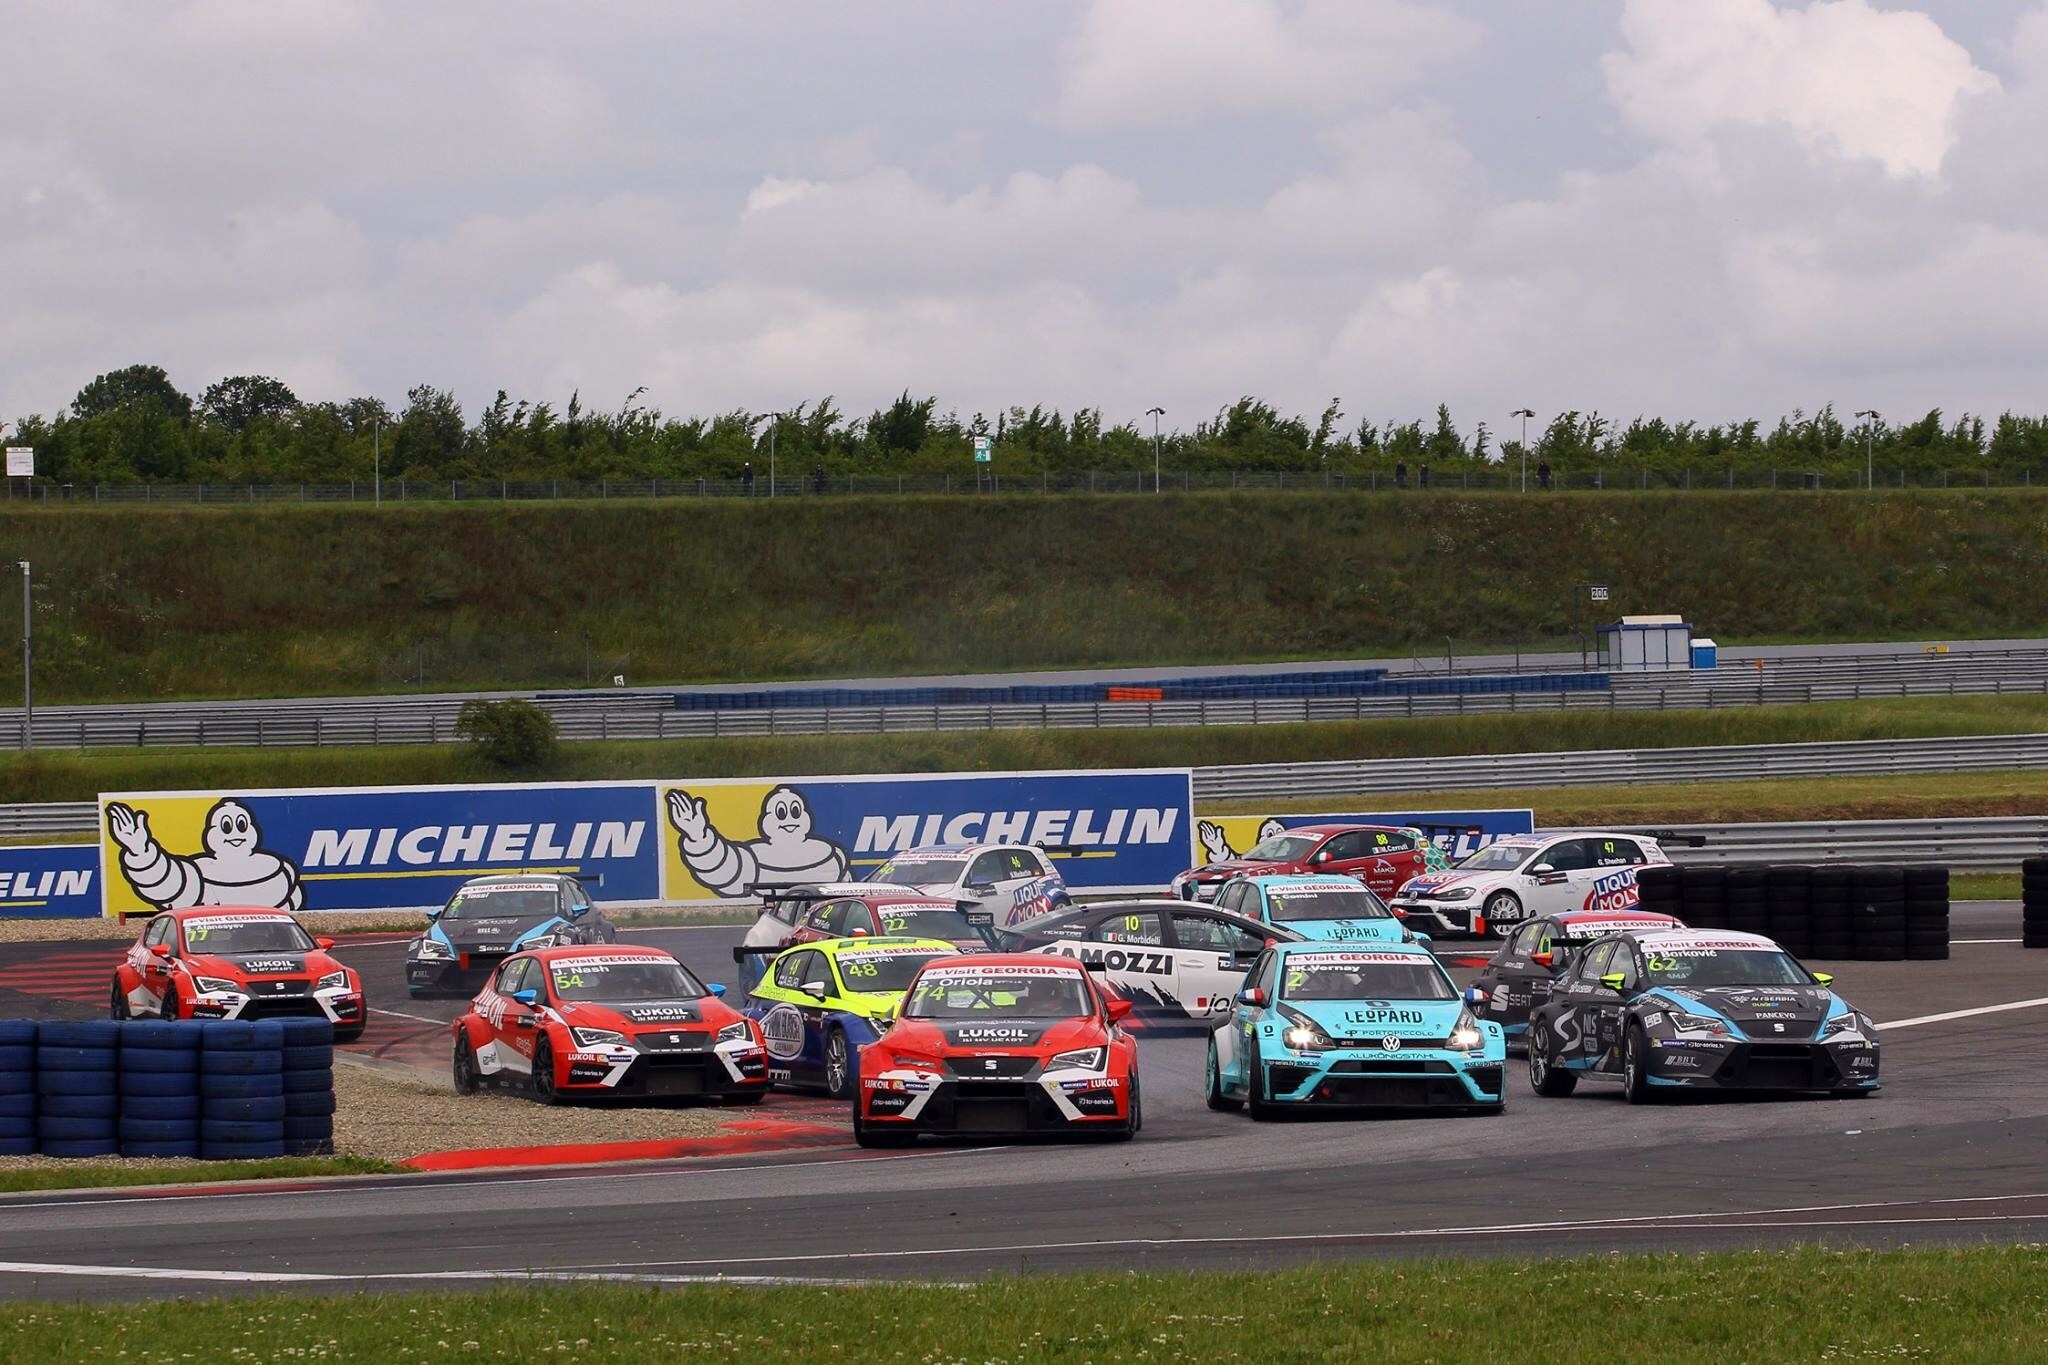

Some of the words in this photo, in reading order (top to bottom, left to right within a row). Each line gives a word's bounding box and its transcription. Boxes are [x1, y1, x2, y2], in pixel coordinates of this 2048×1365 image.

[853, 808, 1179, 853] MICHELIN
[302, 821, 646, 867] MICHELIN
[1376, 834, 1389, 845] 88
[1603, 841, 1614, 853] 47
[1594, 869, 1637, 895] LIQUI
[1013, 880, 1042, 905] LIQUI
[1279, 885, 1302, 893] Visit
[1598, 884, 1640, 911] MOLY
[1016, 896, 1050, 923] MOLY
[884, 918, 908, 932] 22
[1124, 915, 1139, 931] 10
[187, 929, 209, 942] 77
[1327, 927, 1380, 939] LEOPARD
[1117, 934, 1126, 943] G.
[1127, 933, 1161, 946] Morbidelli
[1694, 941, 1761, 949] GEORGIA
[852, 949, 882, 957] Visit
[884, 947, 944, 955] GEORGIA
[1303, 954, 1336, 963] Visit
[1339, 953, 1411, 962] GEORGIA
[246, 960, 295, 968] LUKOIL
[567, 956, 596, 965] Visit
[599, 955, 659, 963] GEORGIA
[1648, 957, 1679, 972] 62
[554, 967, 568, 976] J.
[572, 965, 610, 975] Nash
[849, 963, 878, 977] 48
[943, 967, 977, 976] Visit
[981, 966, 1058, 975] GEORGIA
[555, 974, 585, 989] 54
[941, 977, 993, 988] Oriola
[1287, 972, 1303, 988] 2
[916, 986, 944, 1003] 74
[1509, 994, 1533, 1006] SEAT
[631, 1007, 689, 1017] LUKOIL
[1344, 1009, 1423, 1024] LEOPARD
[958, 1028, 1029, 1038] LUKOIL
[567, 1053, 596, 1062] LUKOIL
[864, 1079, 890, 1090] LUKOIL
[1090, 1079, 1120, 1088] LUKOIL
